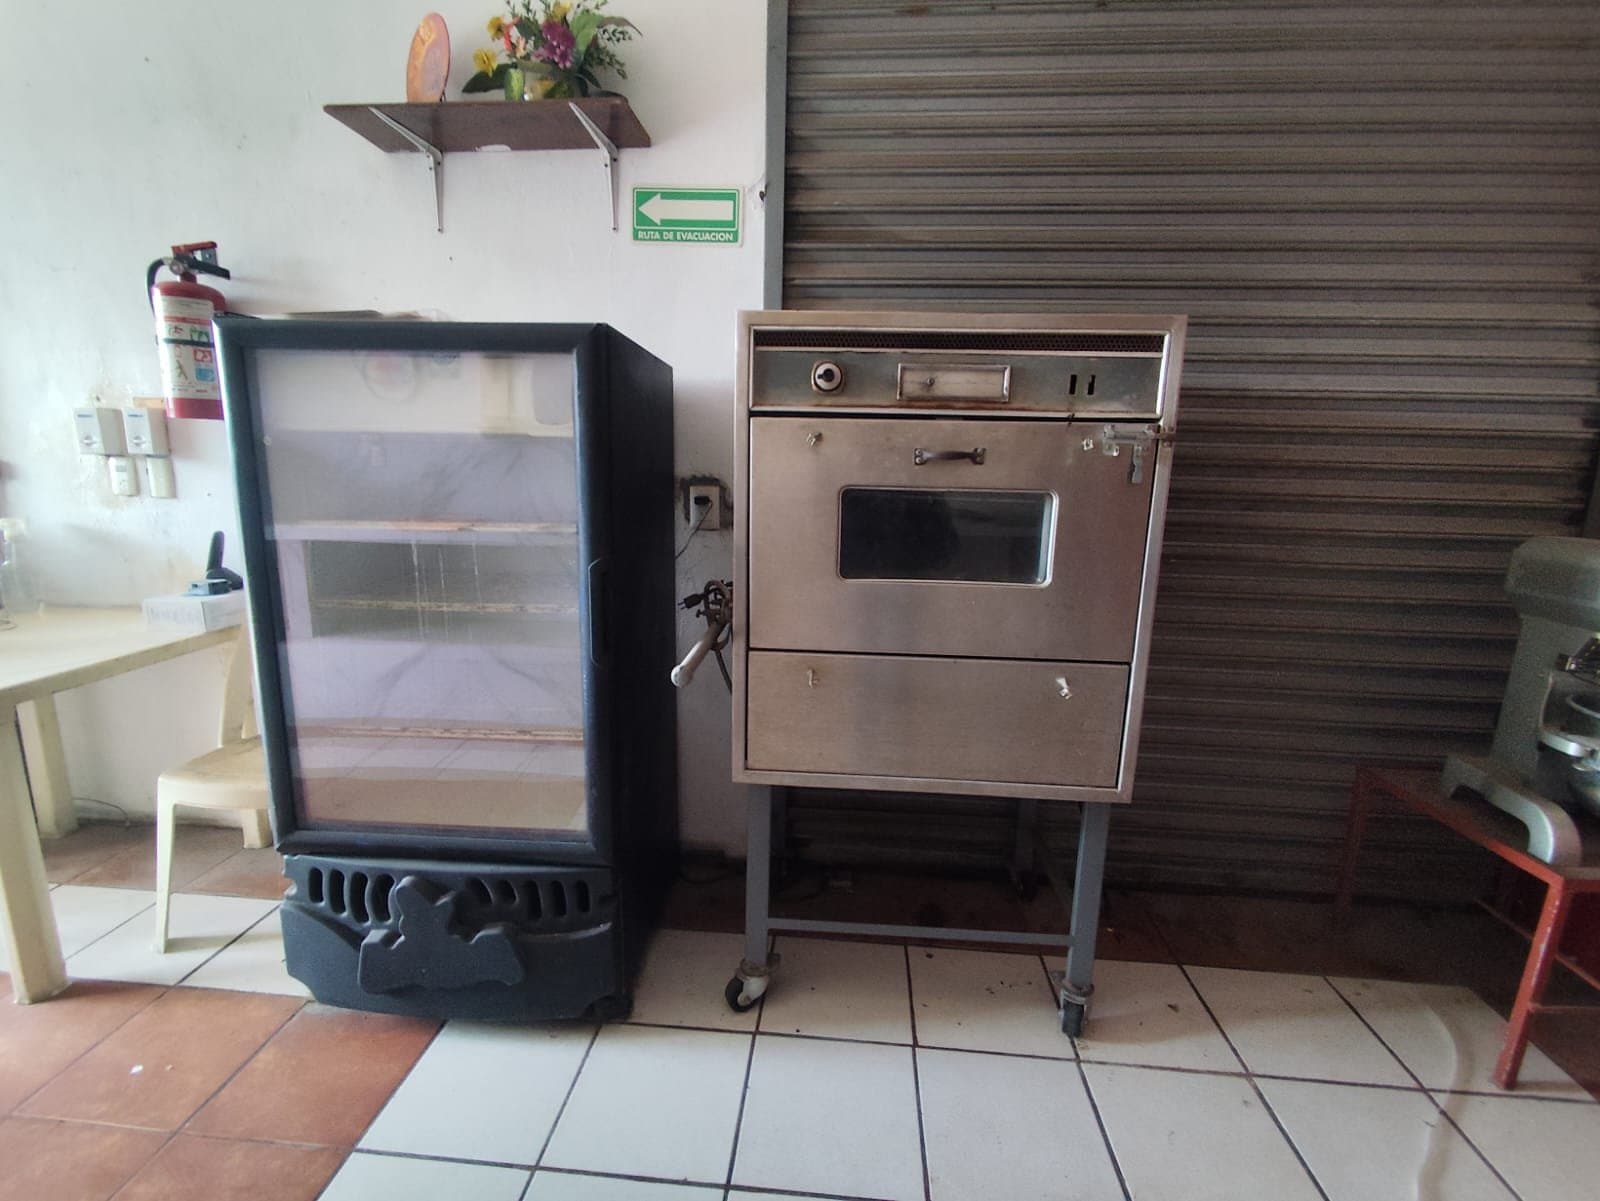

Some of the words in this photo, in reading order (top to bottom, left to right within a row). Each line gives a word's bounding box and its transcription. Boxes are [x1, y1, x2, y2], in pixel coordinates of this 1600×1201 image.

[638, 231, 660, 240] RUTA
[663, 232, 674, 240] DE
[677, 232, 733, 241] EVACUACION
